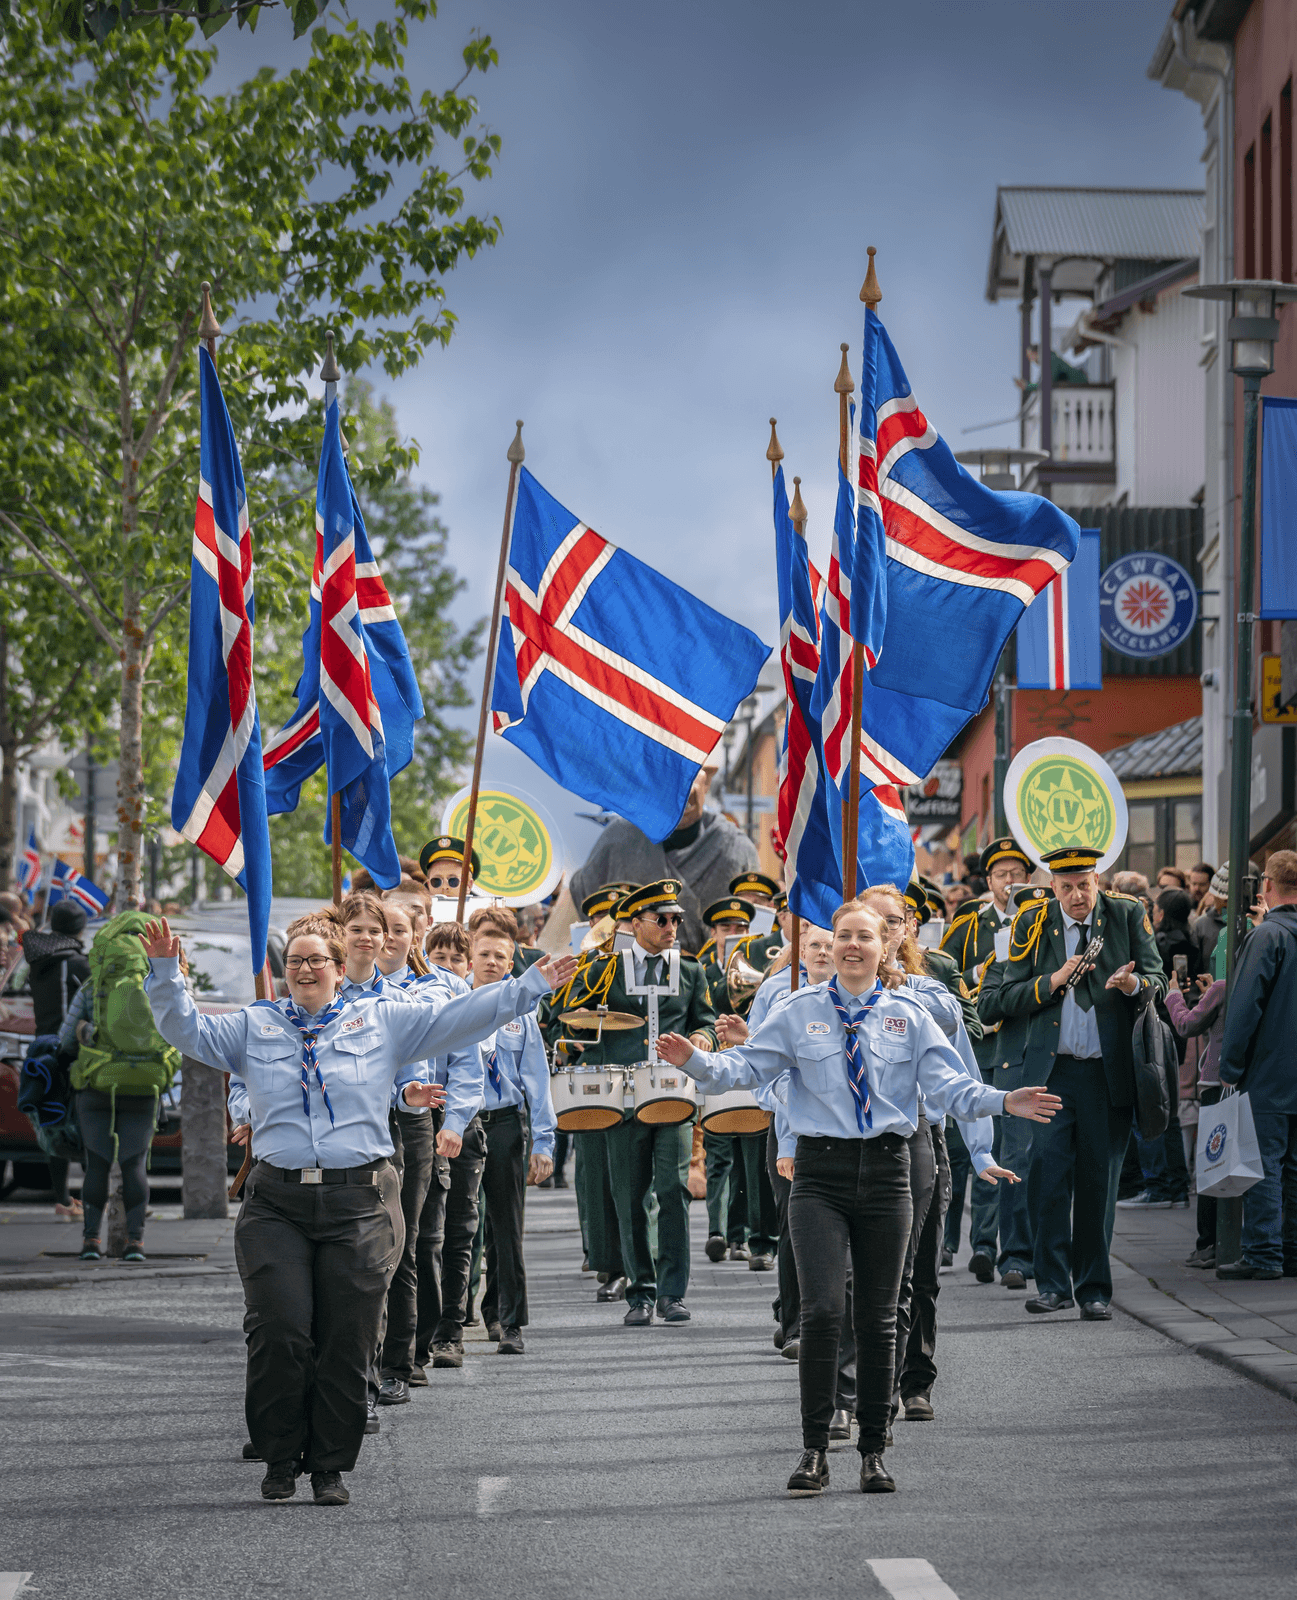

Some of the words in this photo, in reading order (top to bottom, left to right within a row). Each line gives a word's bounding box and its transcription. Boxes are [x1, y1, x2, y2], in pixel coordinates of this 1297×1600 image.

[1100, 559, 1190, 606] ICEWEAR
[1112, 626, 1179, 650] ICELAND
[1053, 798, 1079, 825] LV
[483, 828, 517, 858] LV
